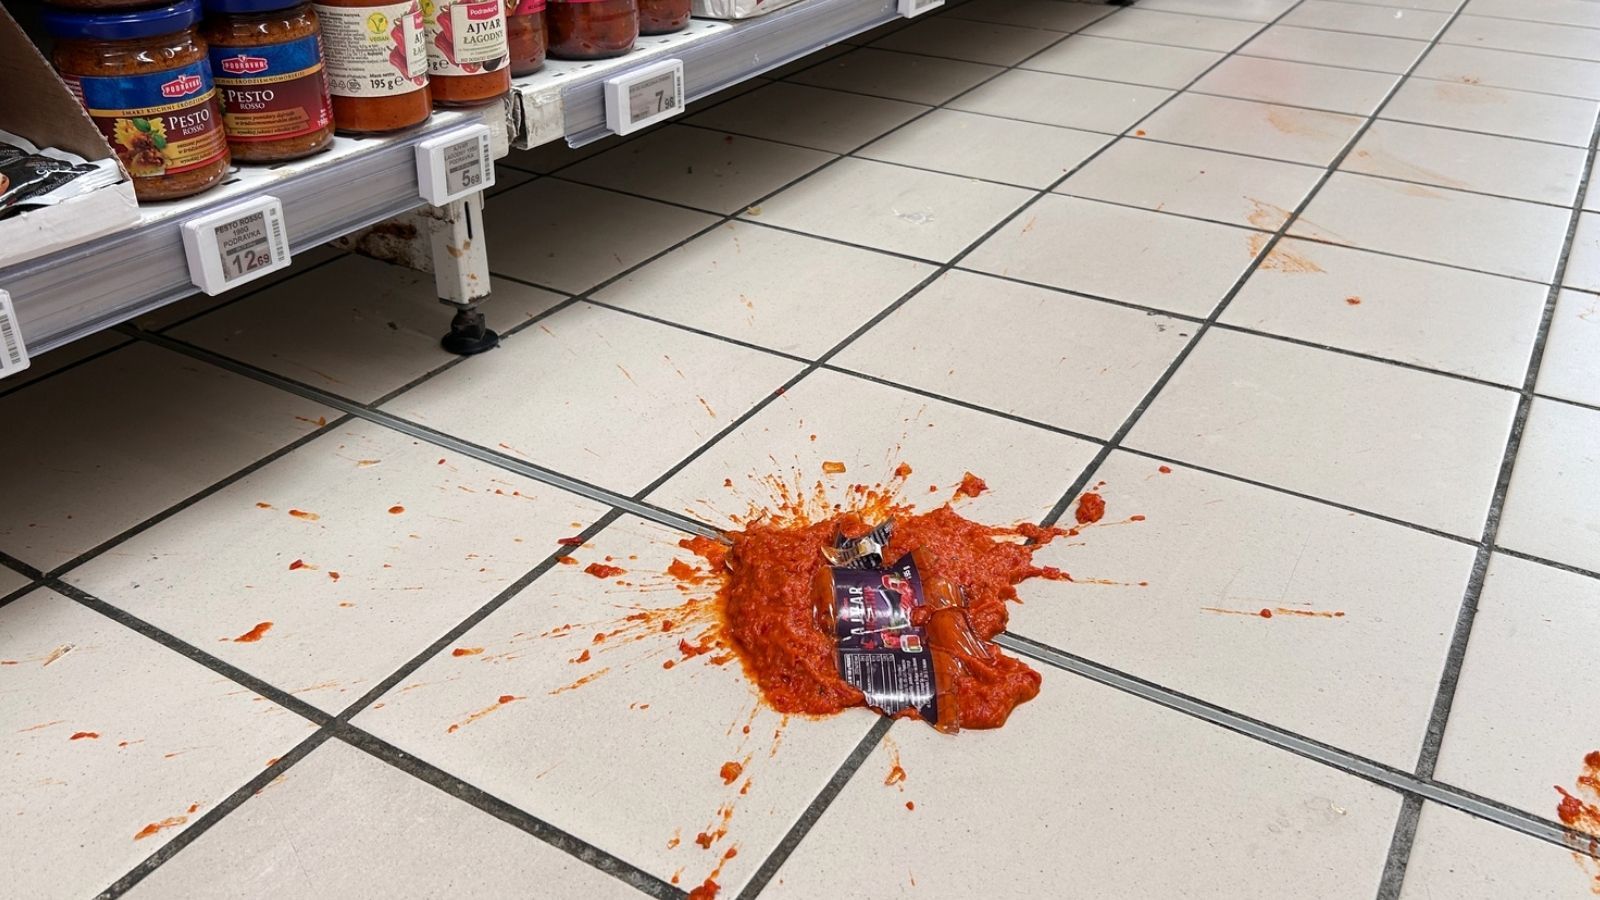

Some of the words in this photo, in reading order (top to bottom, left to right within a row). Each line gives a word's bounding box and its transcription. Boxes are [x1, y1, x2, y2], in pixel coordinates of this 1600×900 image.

[466, 18, 501, 34] AJVAR
[463, 30, 504, 45] ŁAGODNY
[370, 79, 386, 89] 195
[387, 80, 394, 90] g
[227, 90, 274, 103] PESTO
[240, 102, 266, 110] ROSSO
[168, 108, 210, 131] PESTO
[182, 123, 205, 136] ROSSO
[214, 221, 239, 235] PESTO
[239, 212, 264, 226] ROSSO
[223, 229, 261, 248] PODRAVKA
